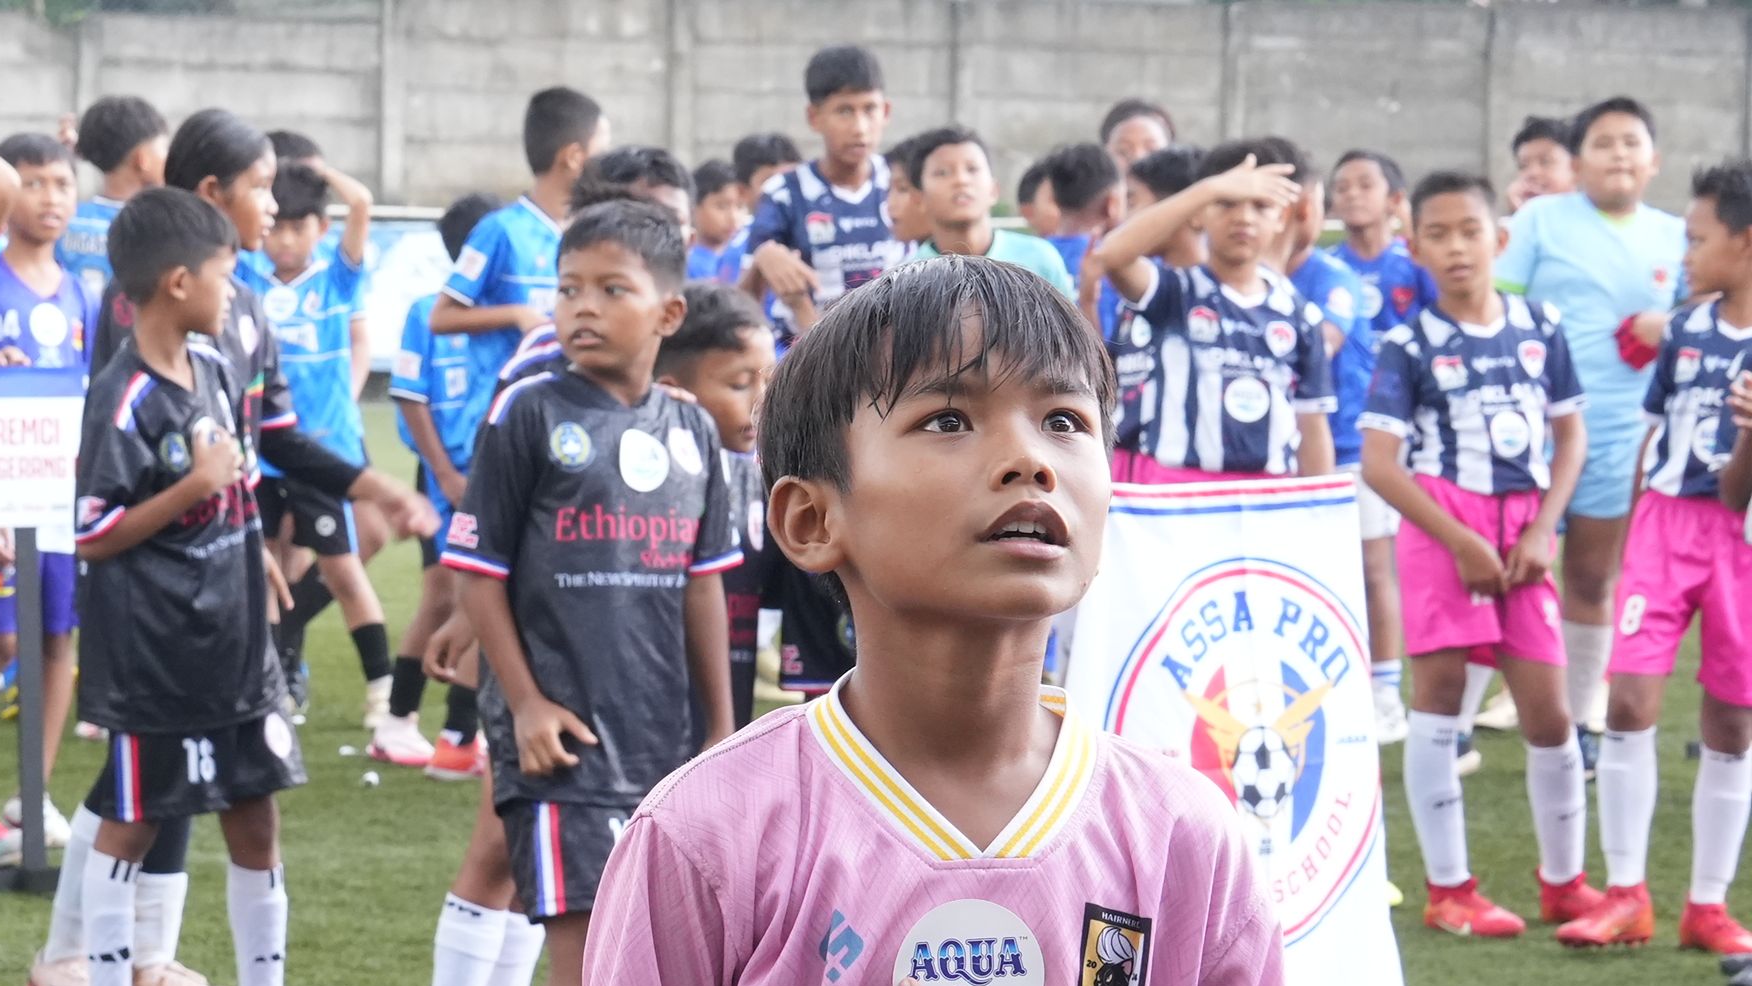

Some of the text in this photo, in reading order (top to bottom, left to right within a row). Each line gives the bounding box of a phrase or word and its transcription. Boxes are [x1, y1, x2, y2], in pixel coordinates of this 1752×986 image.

[1619, 593, 1646, 636] 8
[1160, 590, 1351, 690] ASSA PRO
[907, 936, 1028, 986] AQUA
